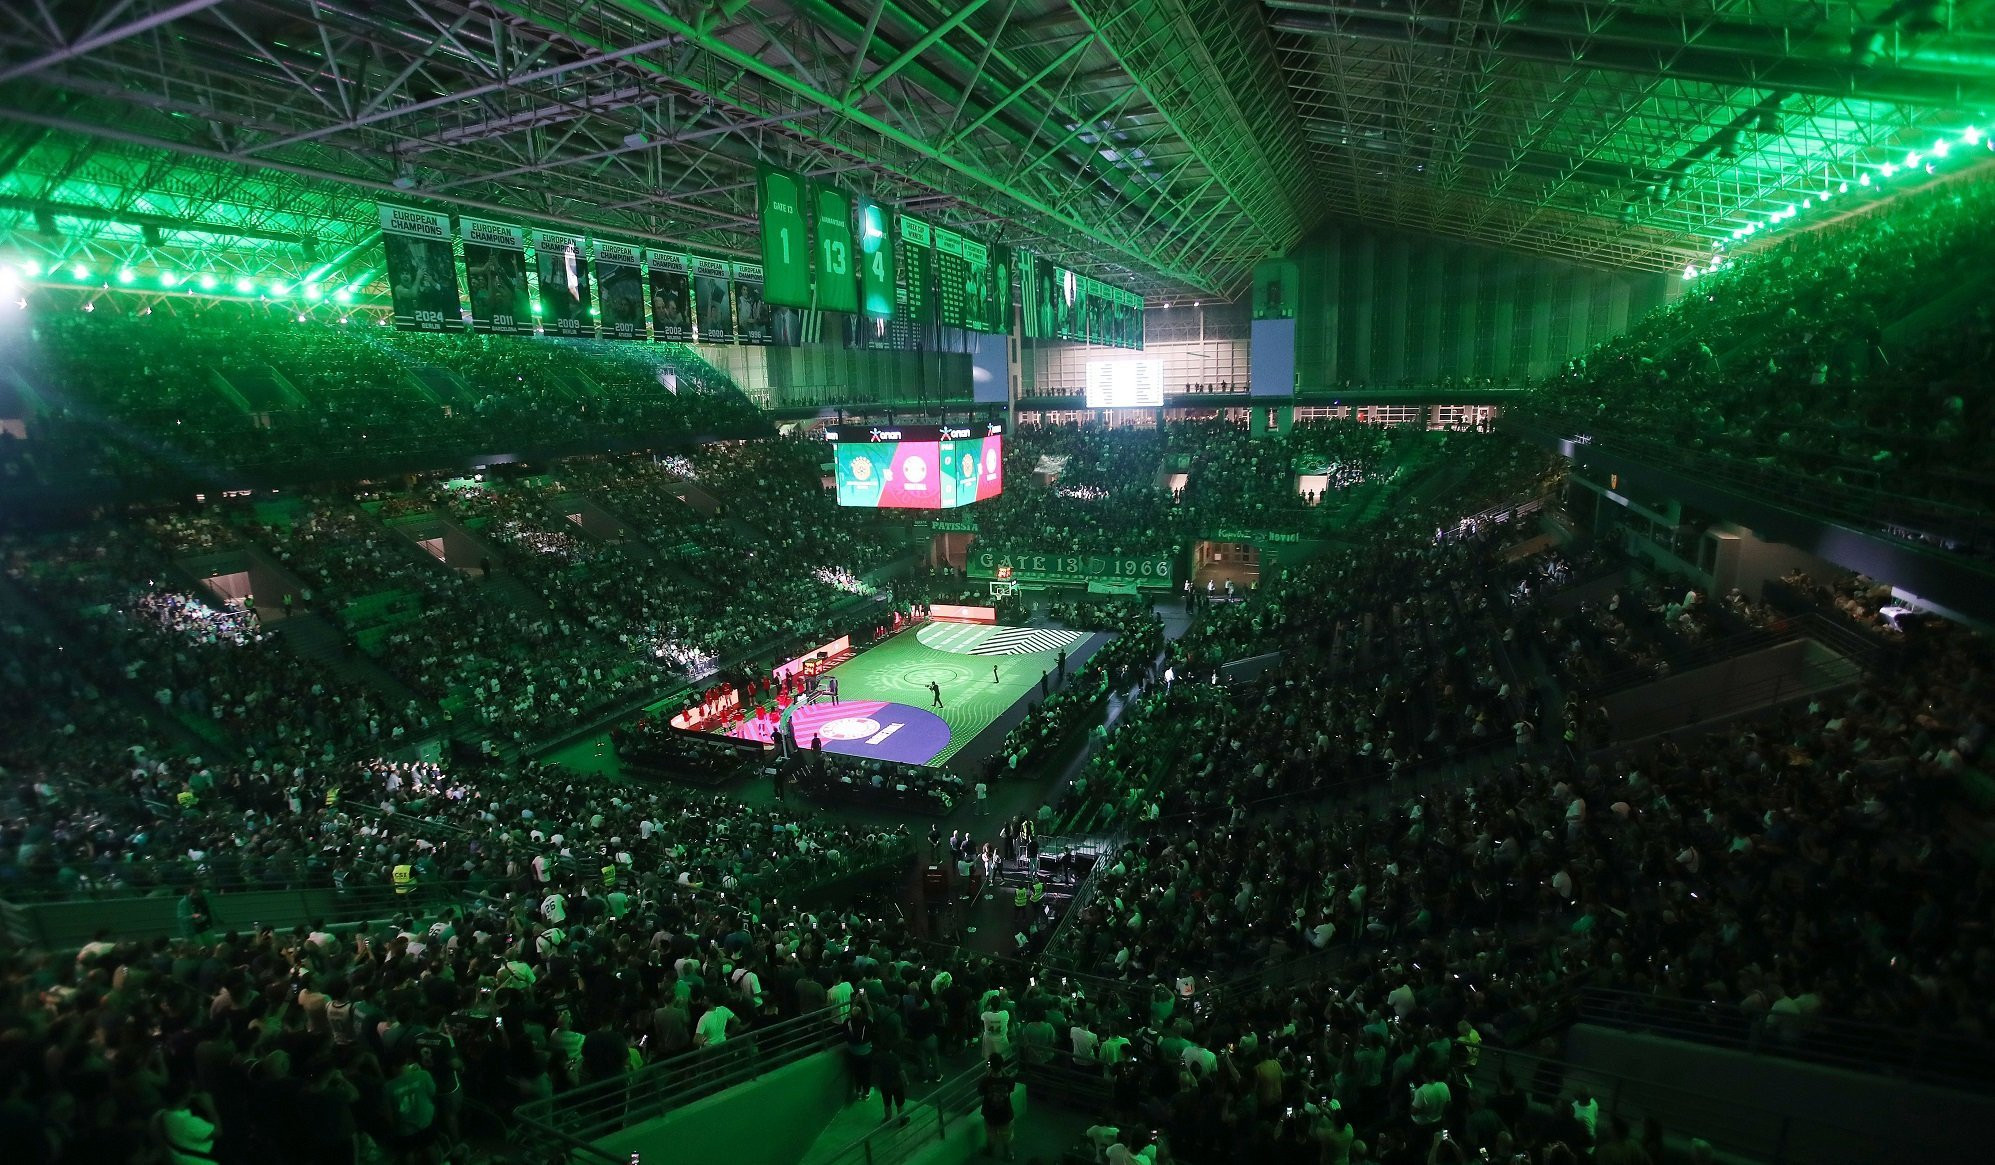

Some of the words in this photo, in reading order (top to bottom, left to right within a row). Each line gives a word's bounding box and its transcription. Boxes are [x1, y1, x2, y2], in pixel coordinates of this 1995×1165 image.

[773, 201, 786, 212] GATE
[787, 205, 793, 214] 13
[393, 210, 438, 226] EUROPEAN
[391, 219, 443, 236] CHAMPIONS
[472, 222, 512, 237] EUROPEAN
[470, 231, 516, 246] CHAMPIONS
[542, 233, 577, 246] EUROPEAN
[540, 241, 580, 255] CHAMPIONS
[602, 244, 632, 256] EUROPEAN
[780, 227, 790, 264] 1
[600, 252, 635, 263] CHAMPIONS
[654, 252, 680, 263] EUROPEAN
[823, 239, 846, 275] 13
[652, 259, 683, 271] CHAMPIONS
[699, 260, 723, 271] EUROPEAN
[739, 266, 762, 275] EUROPEAN
[872, 251, 884, 282] 4
[697, 267, 725, 277] CHAMPIONS
[415, 311, 444, 323] 2024
[493, 314, 514, 326] 2011
[557, 318, 580, 329] 2009
[614, 322, 634, 332] 2007
[664, 326, 682, 335] 2002
[931, 521, 978, 531] PATISSIA
[980, 553, 1047, 570] GATE
[1056, 557, 1079, 573] 13
[1114, 560, 1169, 576] 1966
[545, 901, 556, 914] 26
